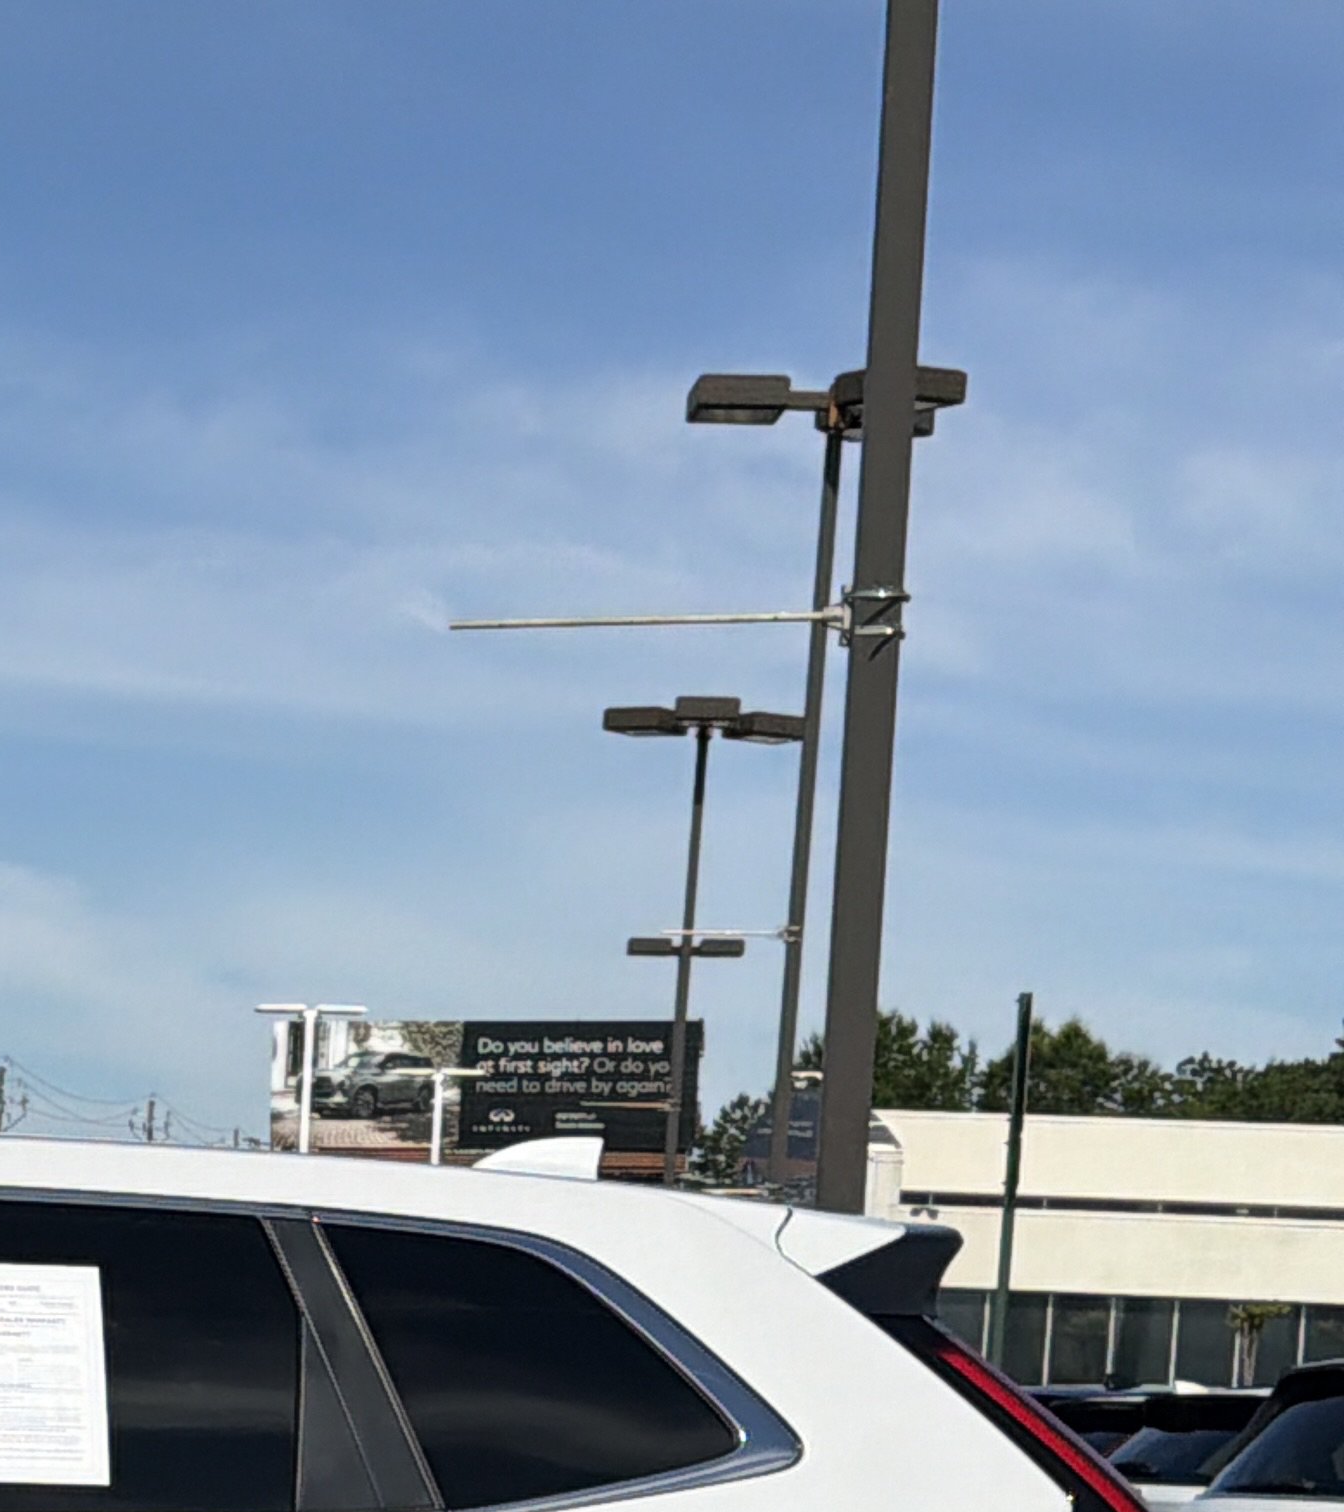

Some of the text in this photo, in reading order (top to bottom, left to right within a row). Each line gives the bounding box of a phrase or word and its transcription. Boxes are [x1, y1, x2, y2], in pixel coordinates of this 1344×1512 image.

[477, 1036, 664, 1056] Do you believe in love
[476, 1057, 671, 1080] at first sight? Or do yo
[475, 1077, 518, 1093] need
[521, 1080, 541, 1093] to
[545, 1079, 587, 1093] drive
[592, 1078, 613, 1096] by
